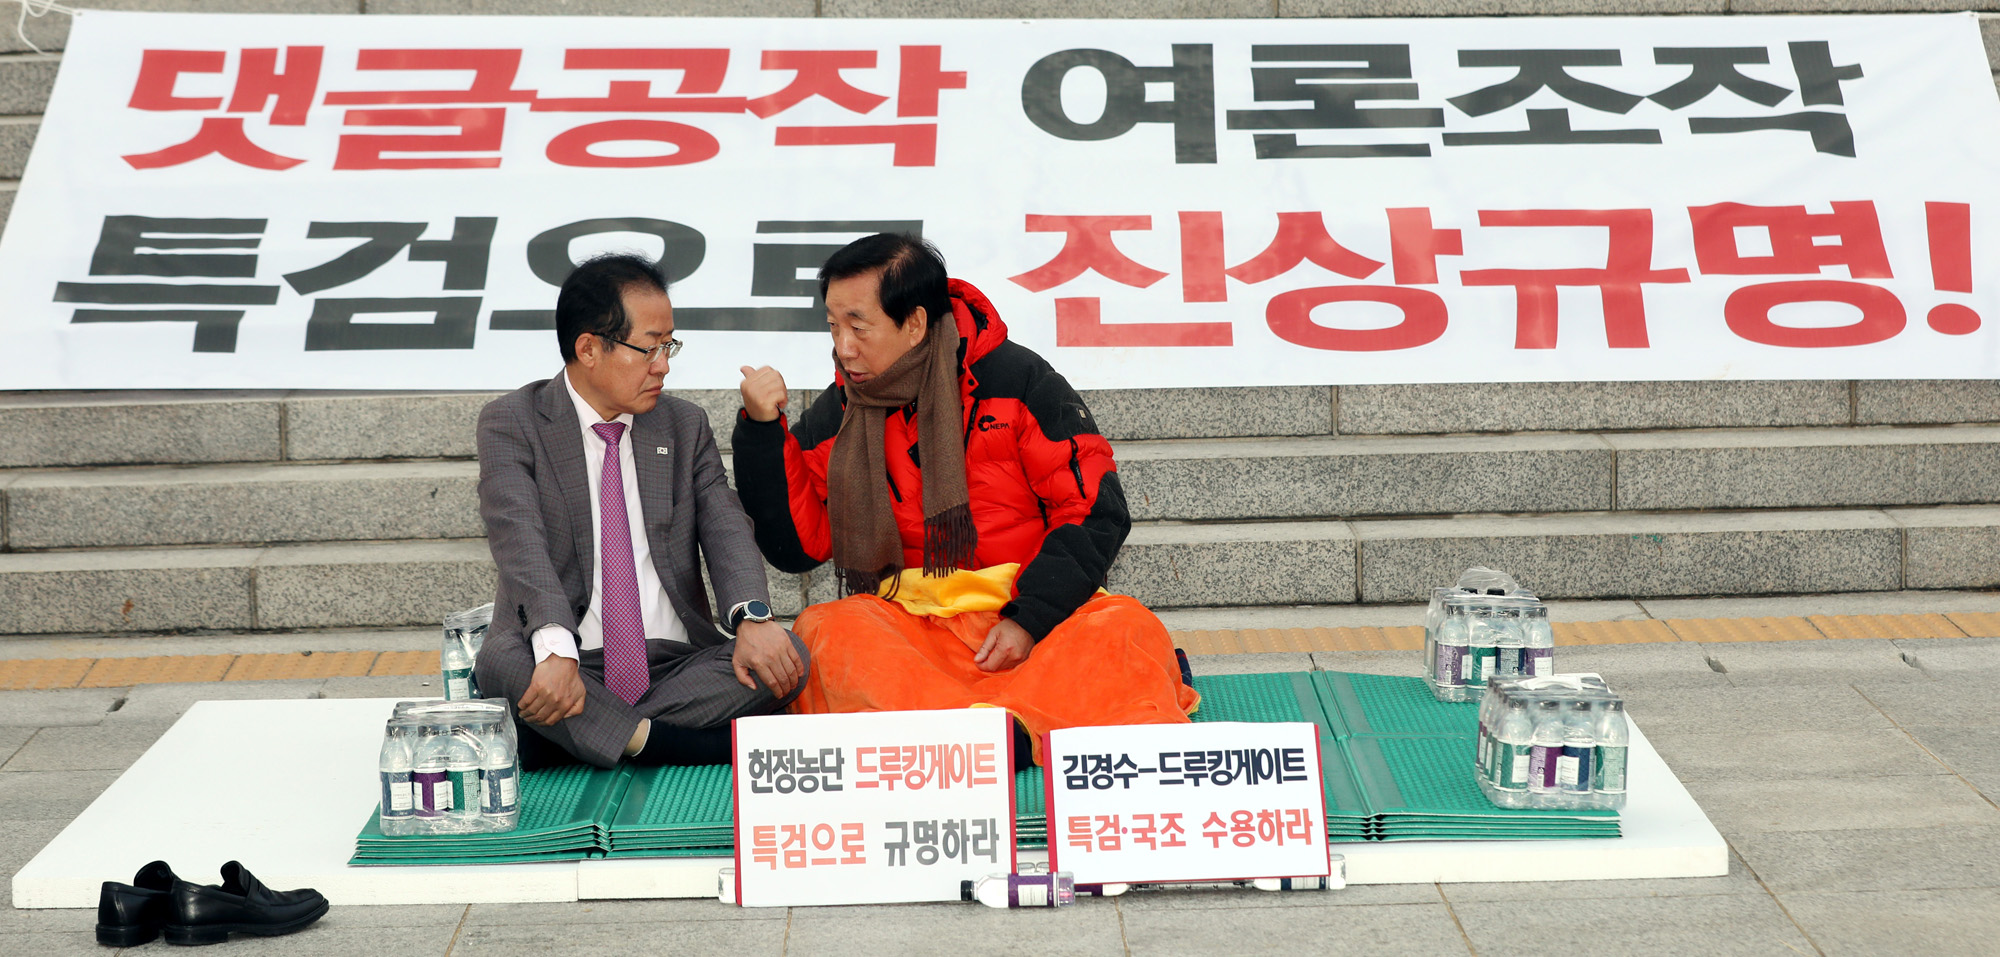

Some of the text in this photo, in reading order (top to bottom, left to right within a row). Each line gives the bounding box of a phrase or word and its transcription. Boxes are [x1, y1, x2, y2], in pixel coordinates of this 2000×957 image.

[122, 41, 1864, 171] 댓글공작 여론조작
[1006, 200, 1982, 352] 진상규명!
[749, 743, 998, 795] 헌정농단 드루킹게이트
[1062, 748, 1309, 791] 김경수-드루킹게이트
[752, 818, 1000, 870] 특검으로 규명하라
[1067, 808, 1314, 853] 특검·국조 수용하라
